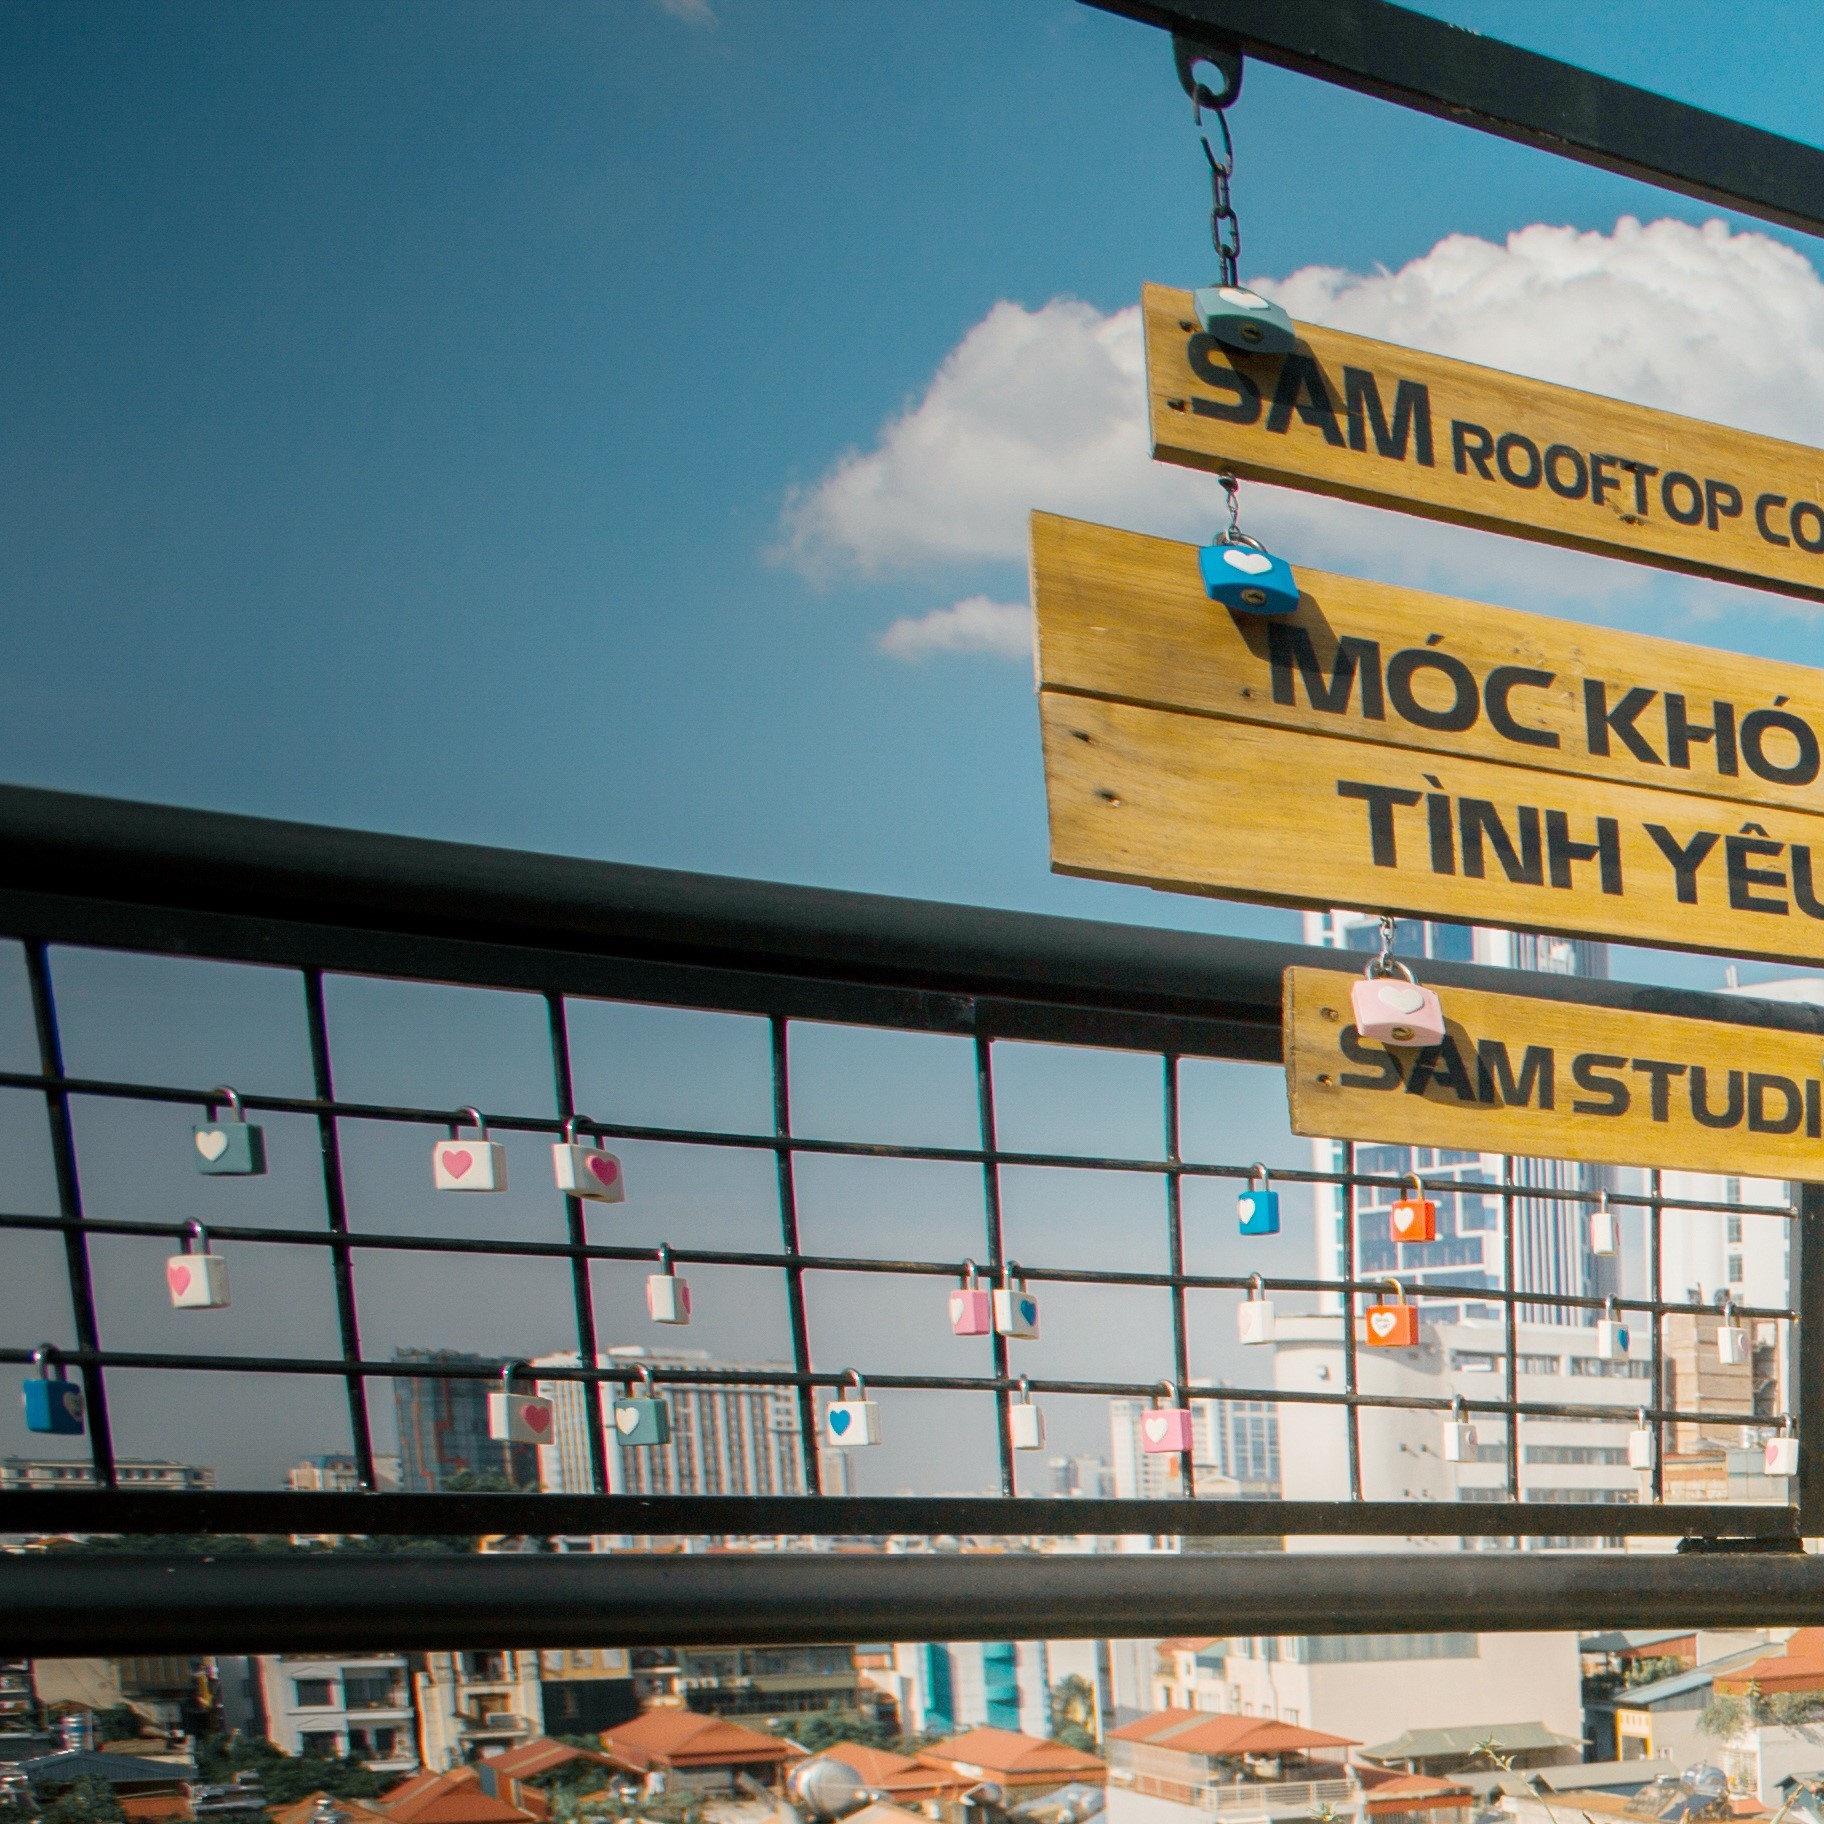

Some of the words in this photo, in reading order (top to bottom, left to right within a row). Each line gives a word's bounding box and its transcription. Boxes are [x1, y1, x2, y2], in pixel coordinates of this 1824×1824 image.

[1187, 332, 1435, 467] SAM
[1451, 418, 1744, 532] ROOFTOP
[1267, 622, 1562, 750] MÓC
[1336, 773, 1624, 897] TÌNH
[1339, 1024, 1556, 1111] SAM
